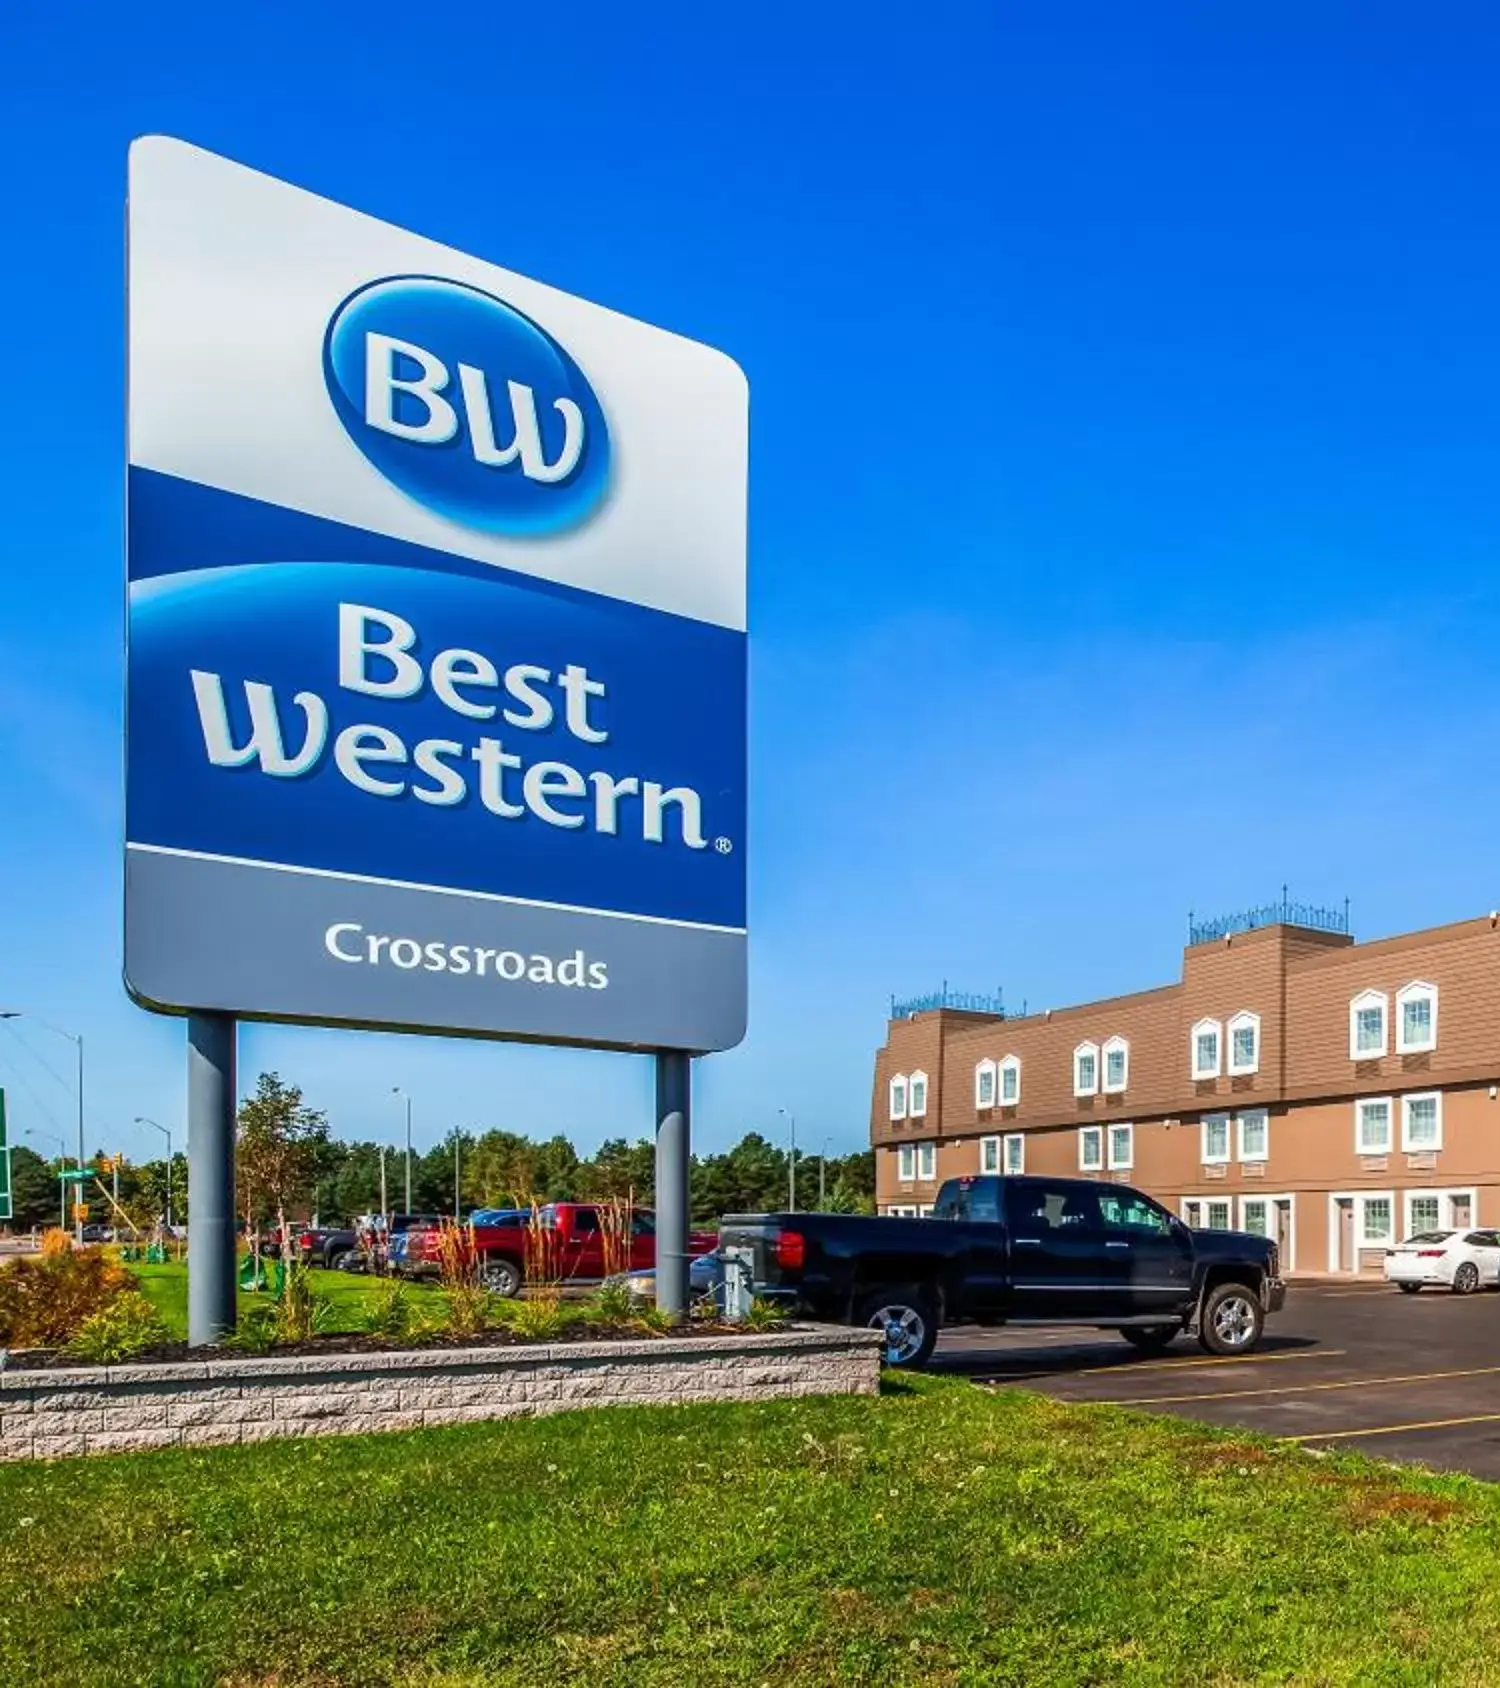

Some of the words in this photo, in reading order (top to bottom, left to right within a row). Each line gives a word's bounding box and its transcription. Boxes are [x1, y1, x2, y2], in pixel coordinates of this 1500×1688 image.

[364, 331, 586, 482] BW
[337, 602, 608, 743] Best
[324, 920, 609, 990] Crossroads
